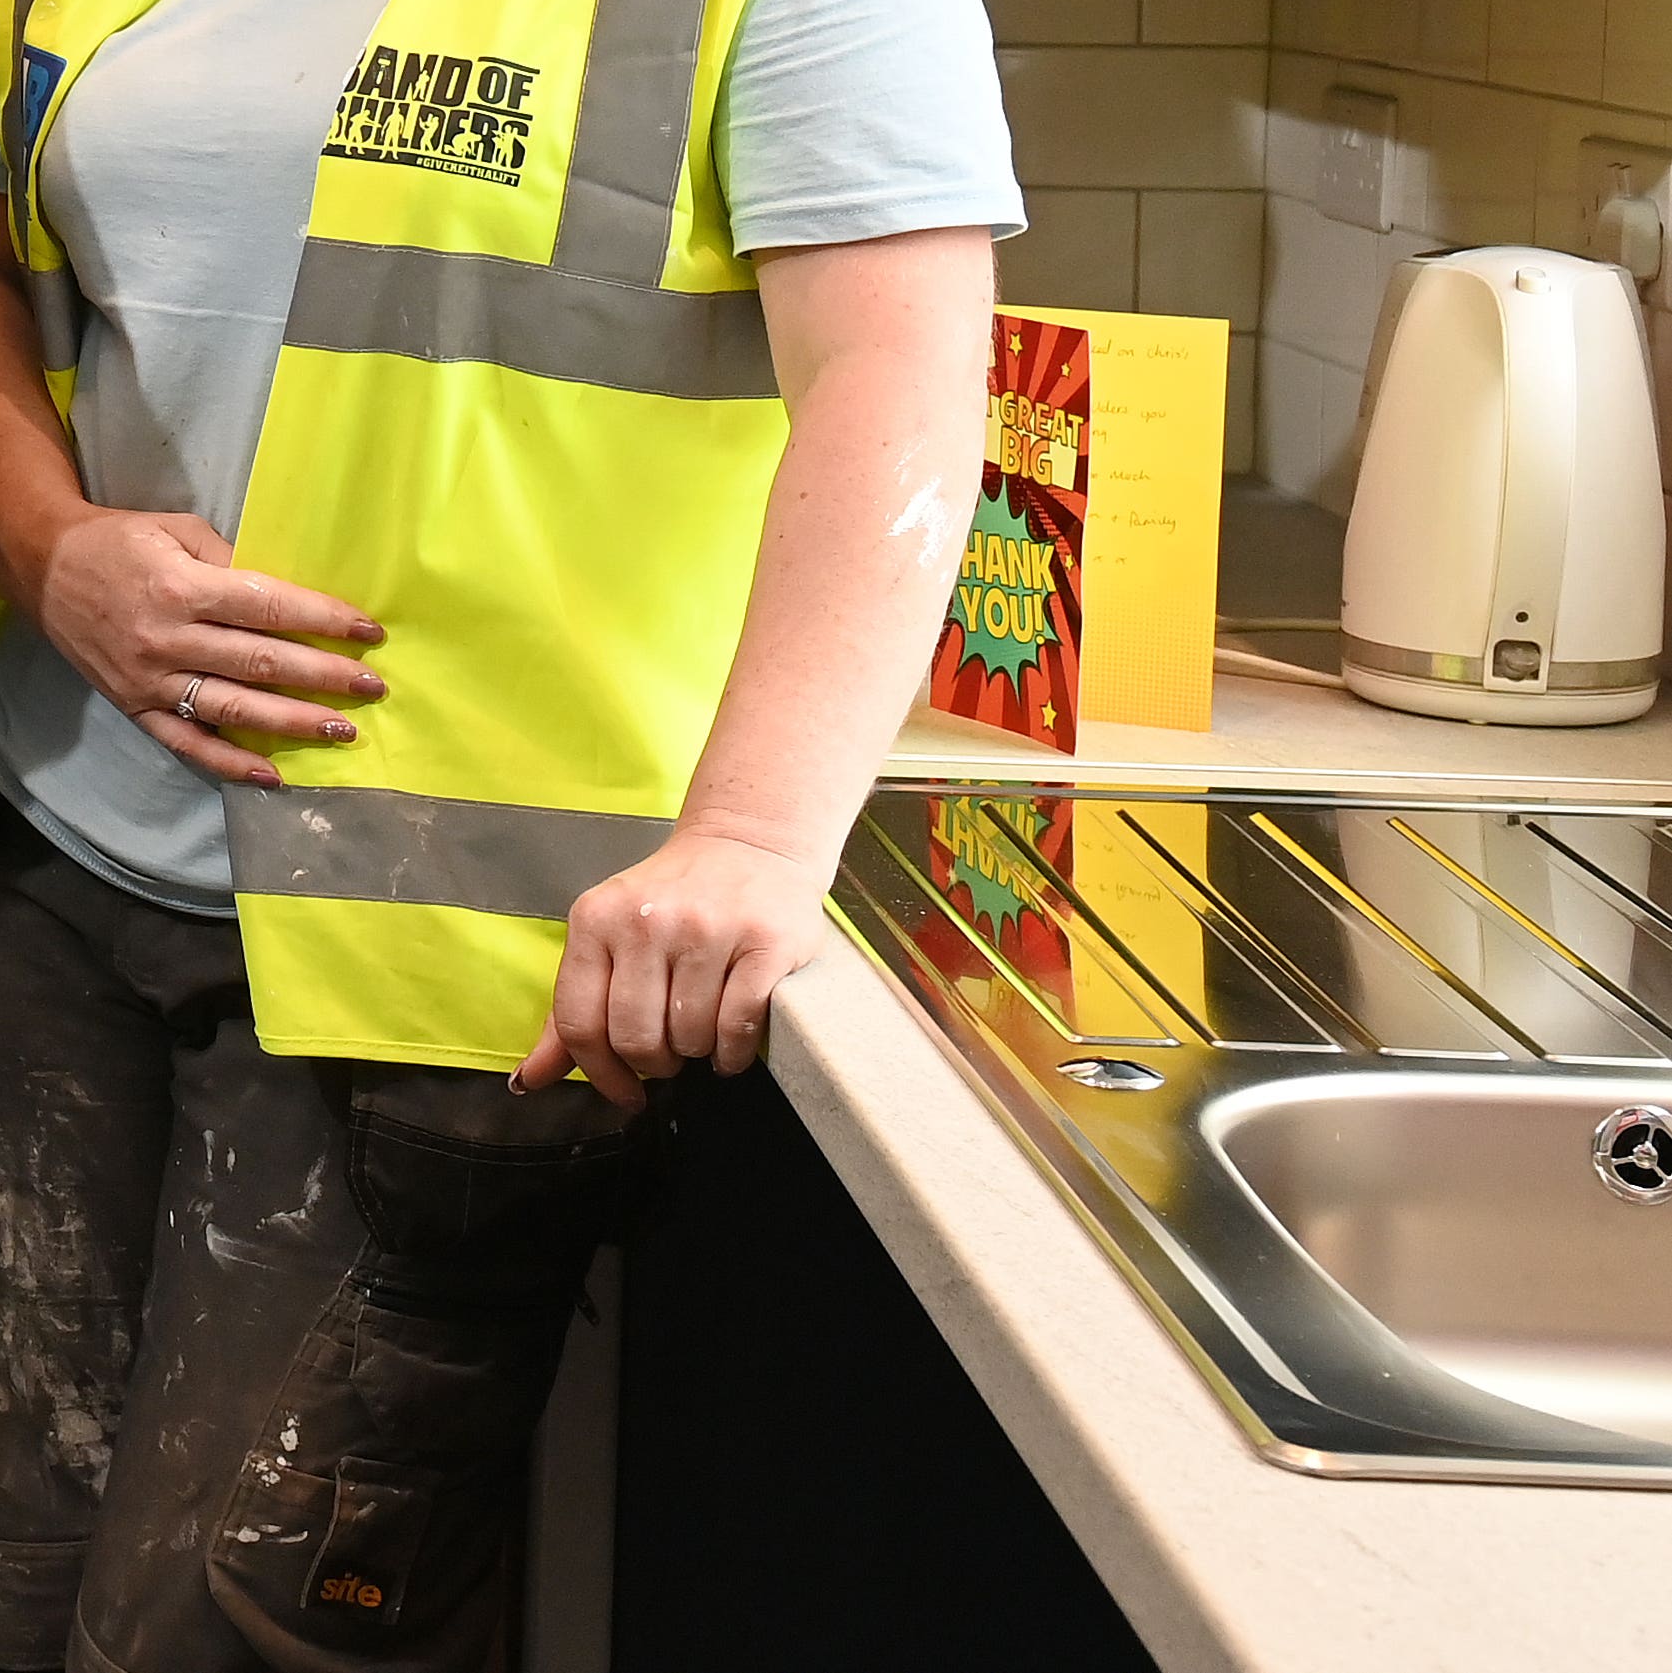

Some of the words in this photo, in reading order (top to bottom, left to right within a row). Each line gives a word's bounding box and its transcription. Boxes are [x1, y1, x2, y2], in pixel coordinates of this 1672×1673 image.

[477, 65, 534, 110] OF
[999, 390, 1084, 449] GREAT
[1000, 426, 1053, 486] BIG
[960, 530, 1057, 593] HANK
[957, 584, 1047, 646] YOU!
[320, 1571, 382, 1608] site
